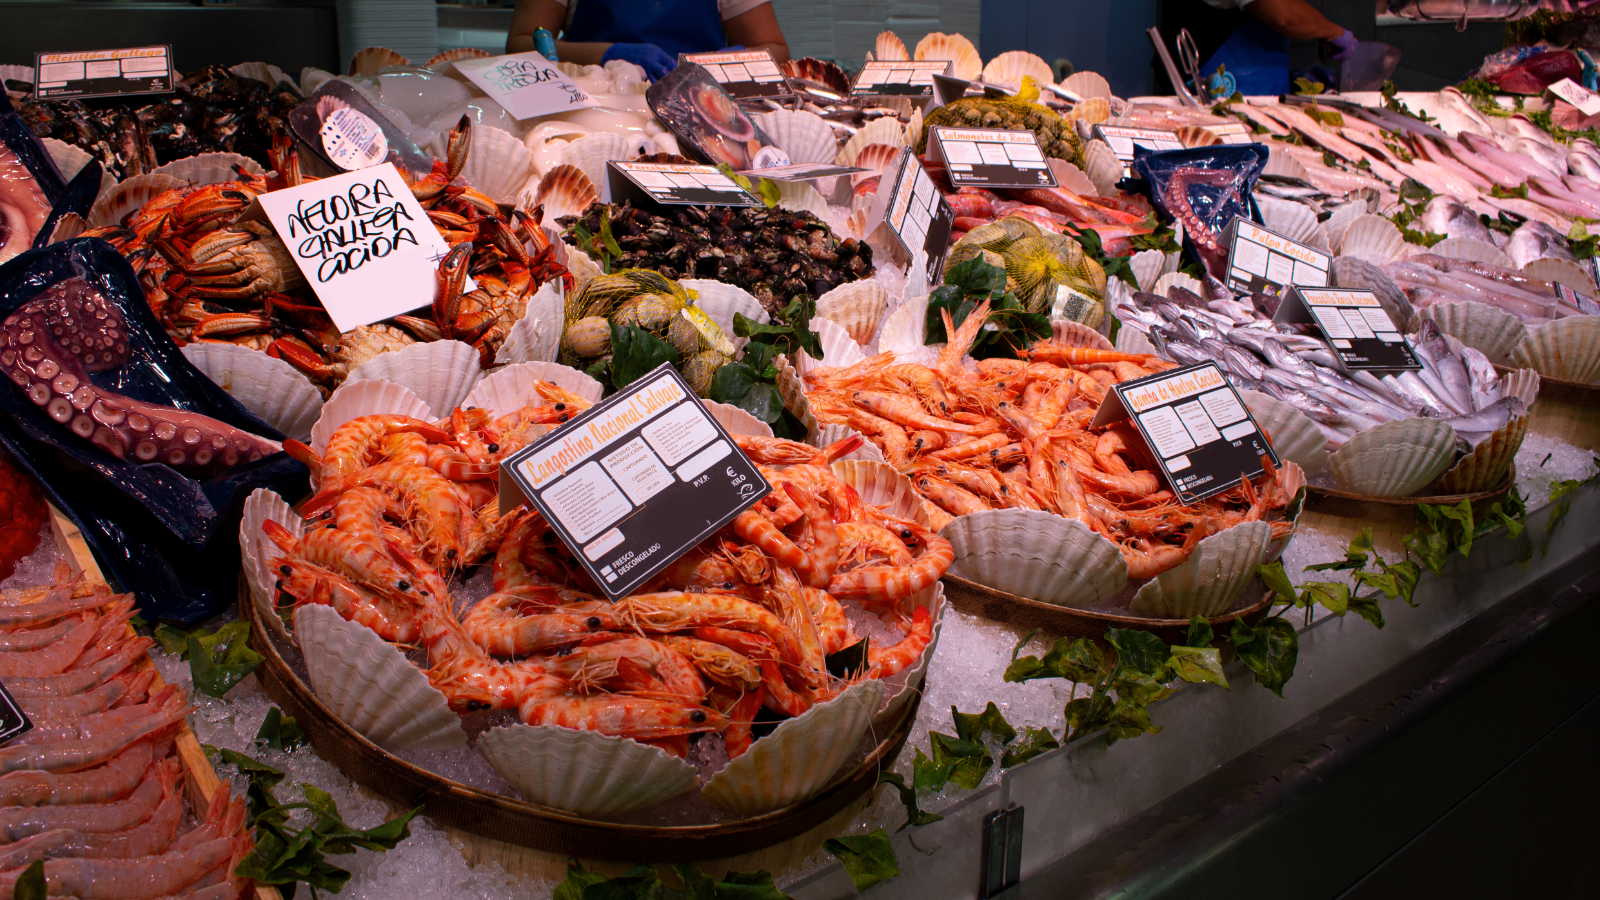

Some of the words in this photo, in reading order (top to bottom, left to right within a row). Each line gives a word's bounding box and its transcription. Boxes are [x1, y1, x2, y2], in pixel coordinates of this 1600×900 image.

[46, 54, 105, 63] Mejillón
[111, 49, 163, 59] Gallego
[689, 55, 731, 65] Boquerón
[733, 52, 768, 62] Barbate
[942, 130, 994, 142] Salmonetes
[997, 133, 1007, 142] de
[1009, 134, 1032, 143] Roca
[1102, 127, 1135, 138] Sardina
[1138, 131, 1176, 141] Parrocha
[624, 163, 668, 171] Percebe
[1252, 228, 1280, 249] Pulpo
[1283, 242, 1316, 263] Cocido
[1127, 387, 1160, 412] Gamba
[1155, 383, 1171, 400] de
[1165, 377, 1197, 397] Huelva
[1192, 368, 1222, 389] Cocida
[525, 435, 594, 484] Langostino
[587, 399, 644, 444] Nacional
[635, 380, 681, 414] Salvaje
[622, 454, 648, 472] CAPTURADO
[645, 468, 657, 477] DULCE
[726, 466, 737, 477] €
[693, 474, 710, 487] P.V.P.
[731, 474, 746, 487] KILO
[601, 529, 617, 541] ORIGEN
[612, 551, 634, 568] FRESCO
[617, 543, 661, 576] DESCONGELADO
